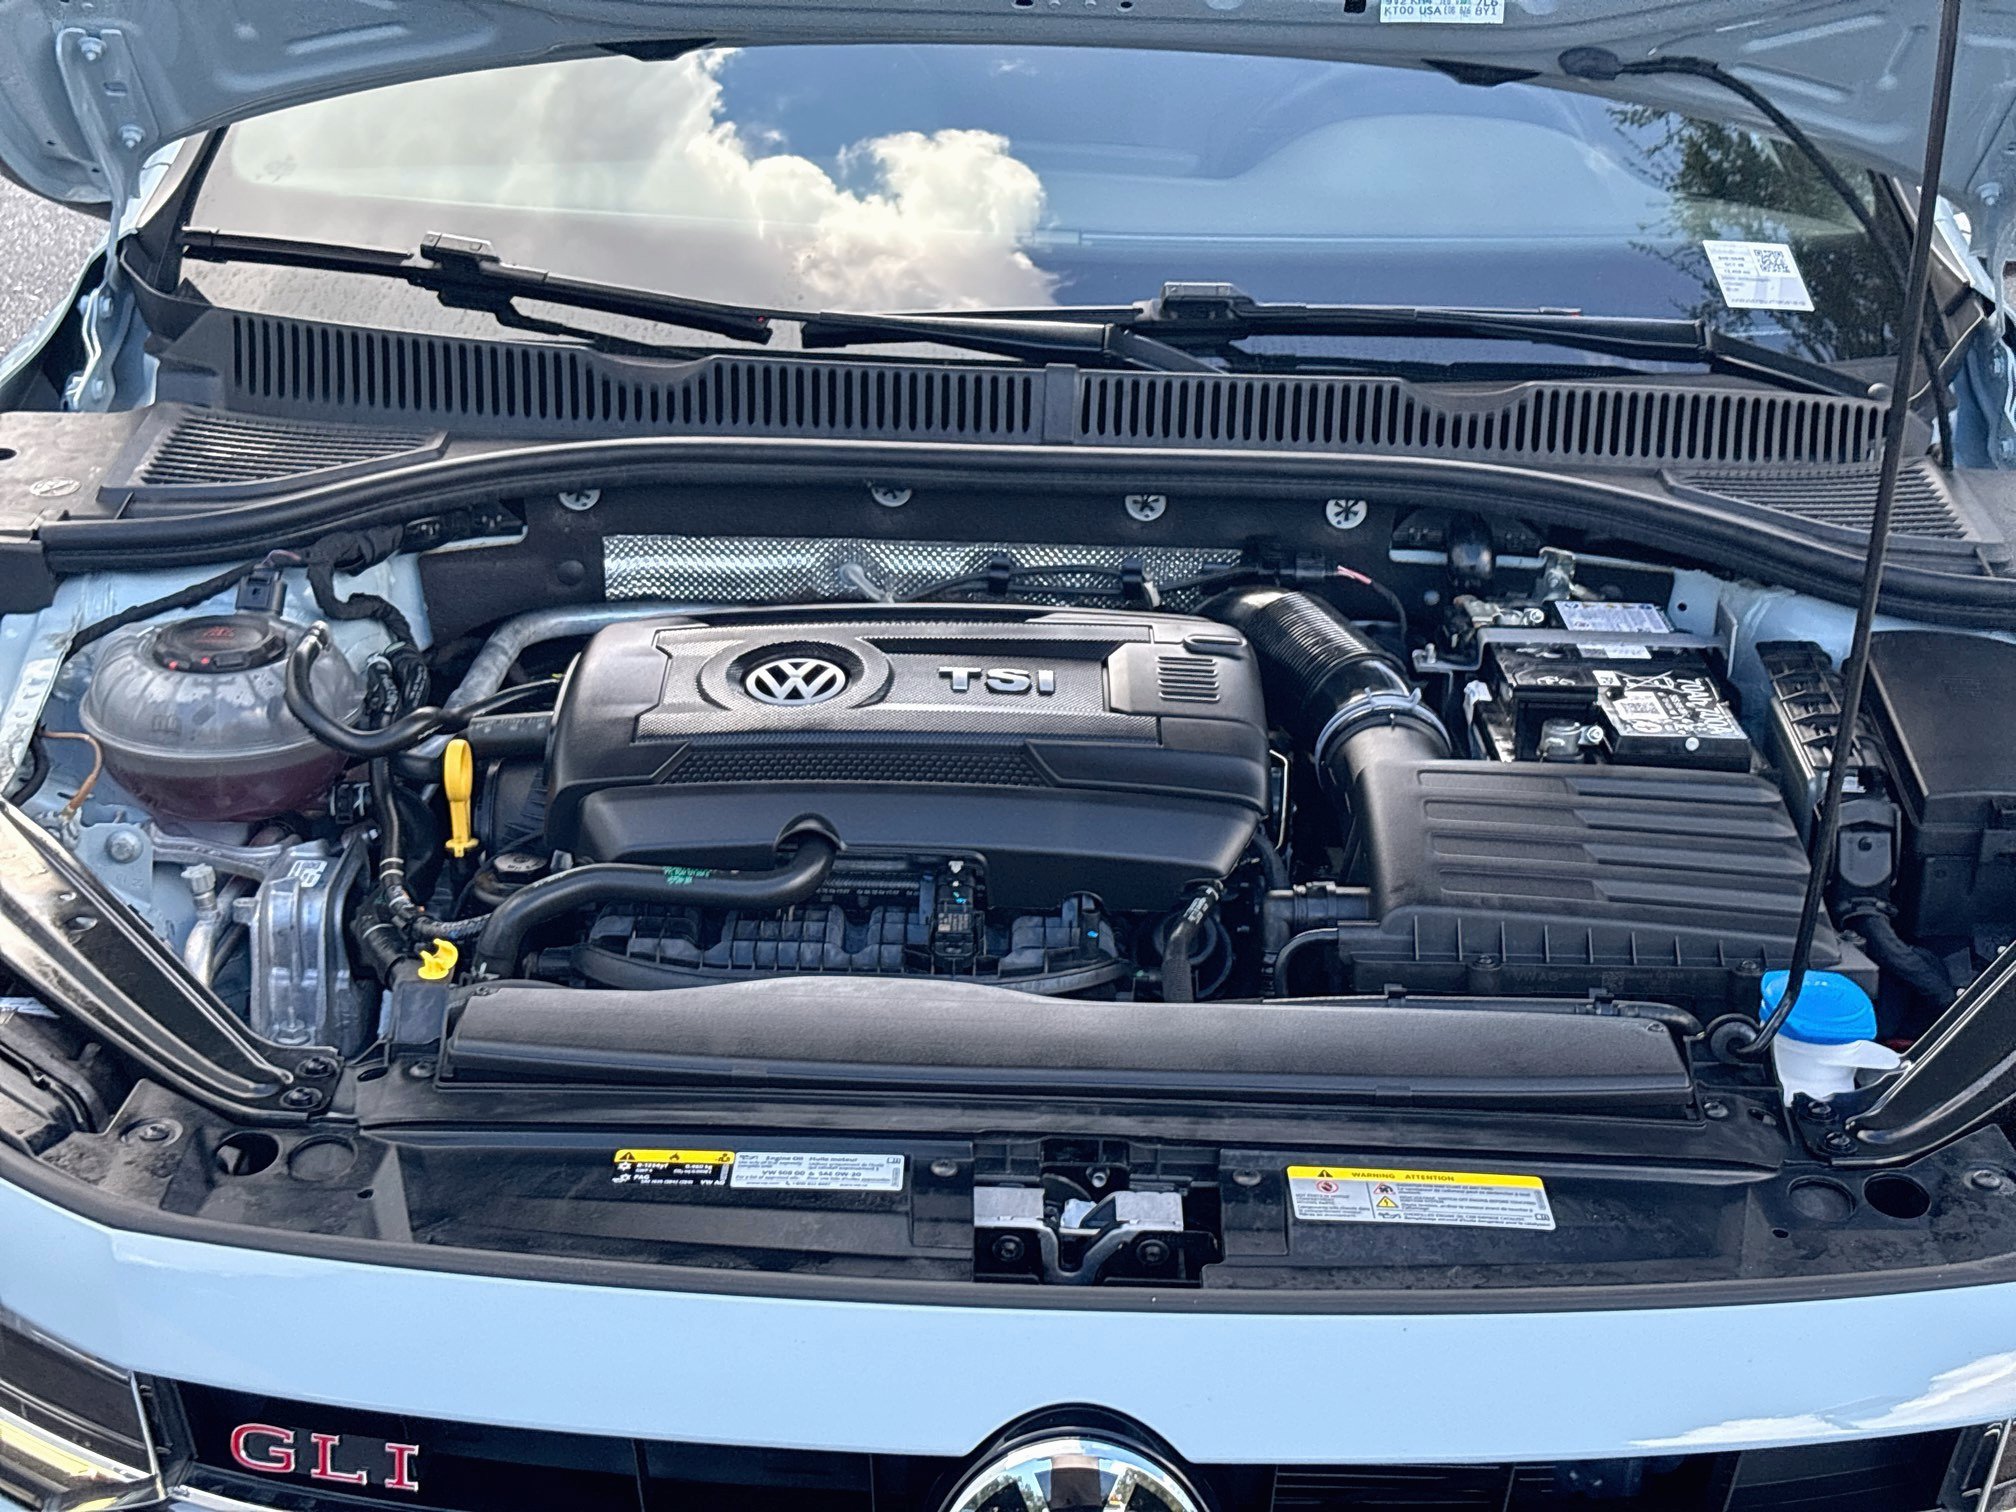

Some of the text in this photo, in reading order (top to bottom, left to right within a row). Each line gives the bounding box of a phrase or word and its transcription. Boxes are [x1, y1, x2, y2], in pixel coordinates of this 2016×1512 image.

[1419, 6, 1442, 15] USA
[938, 666, 1056, 695] TSI
[1695, 707, 1734, 734] 700A
[1405, 1174, 1455, 1182] ATTENTION
[230, 1422, 420, 1492] GLI
